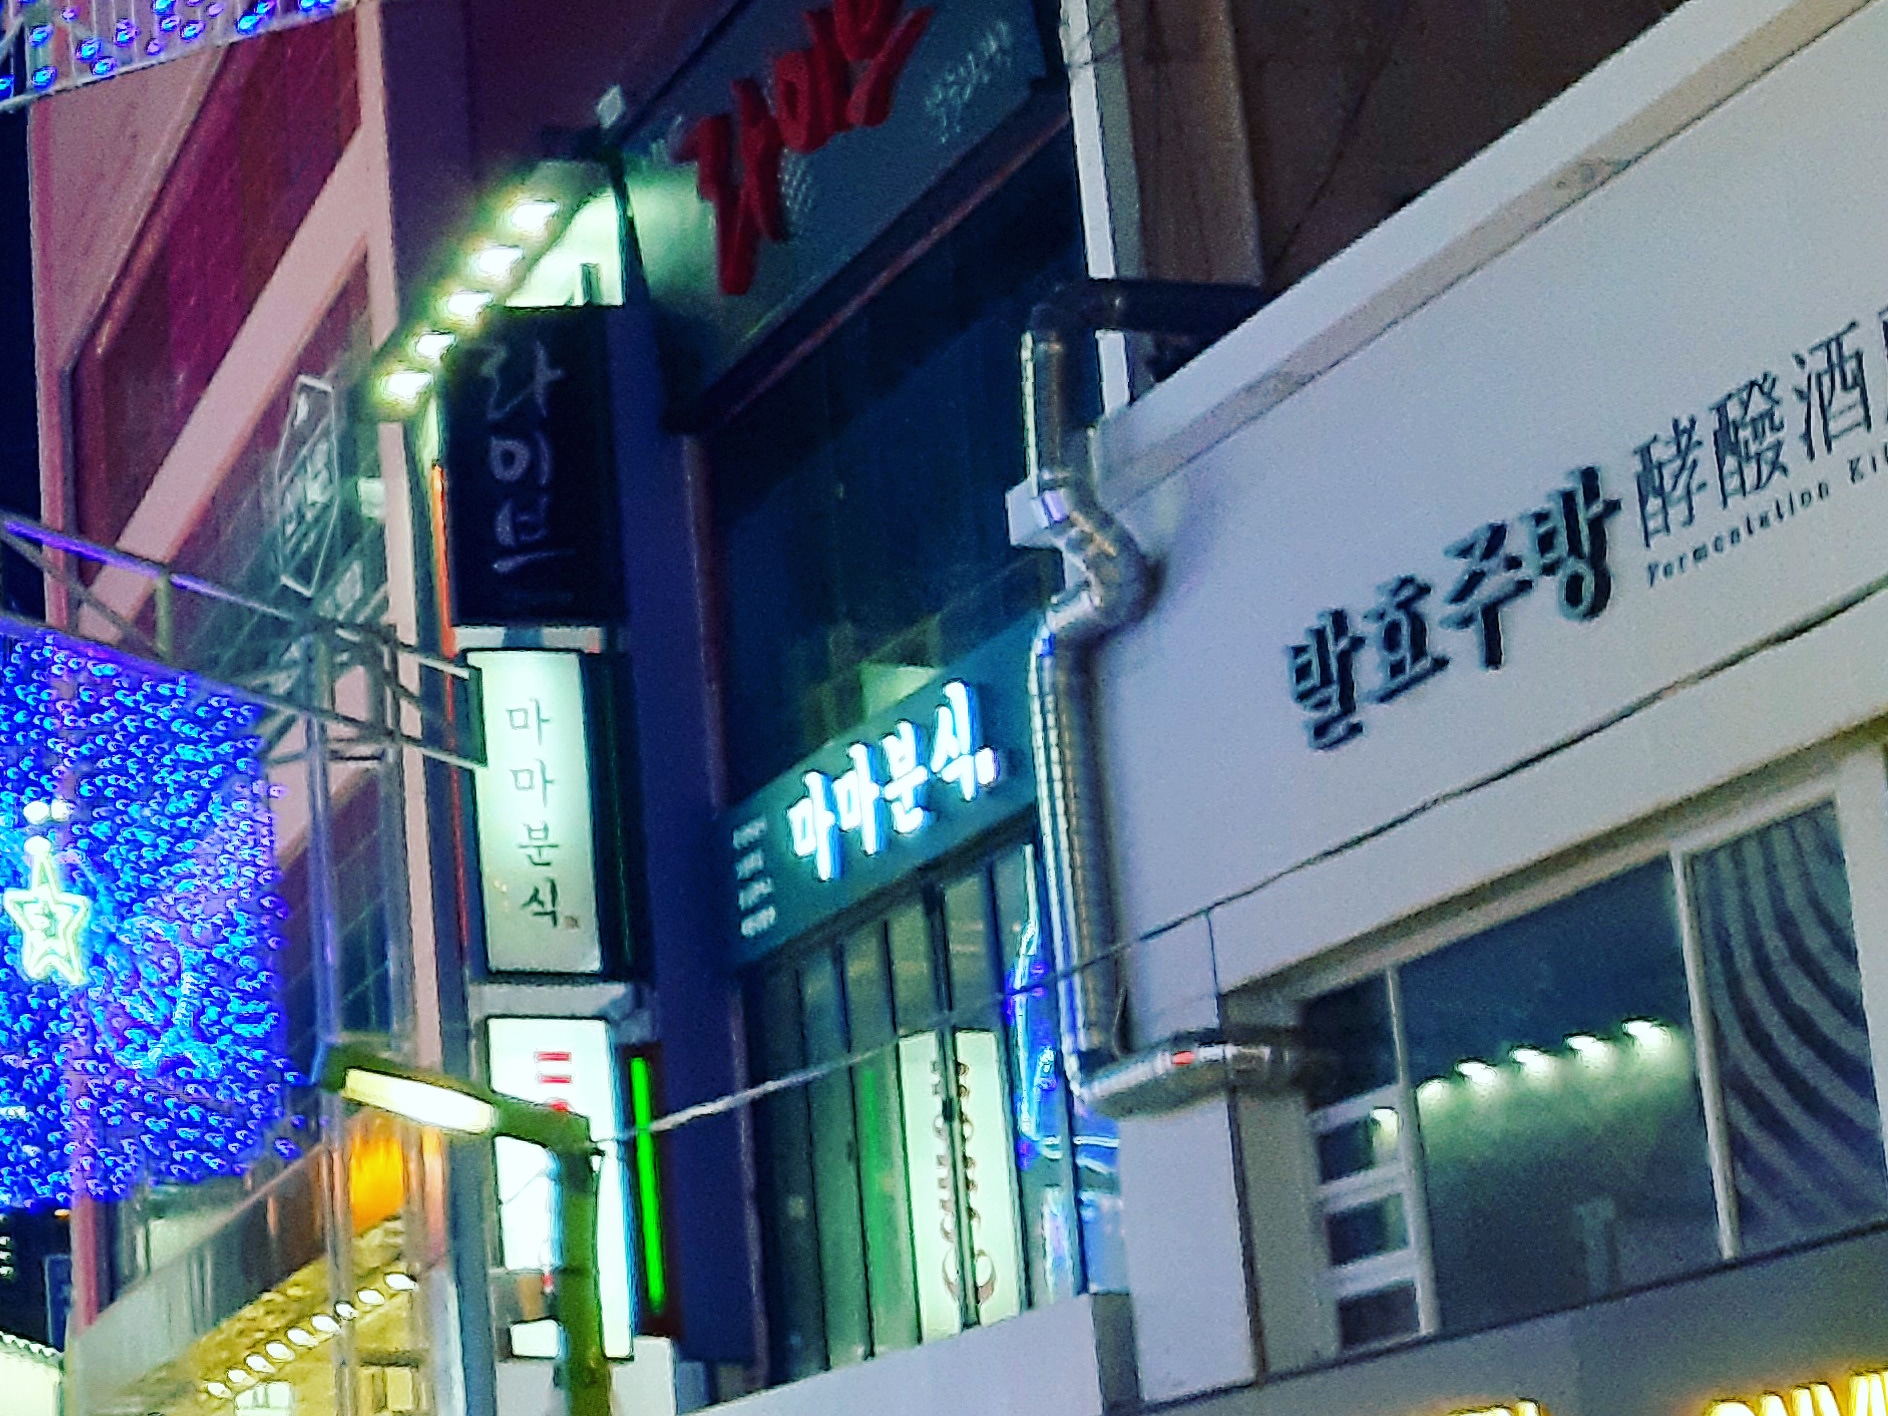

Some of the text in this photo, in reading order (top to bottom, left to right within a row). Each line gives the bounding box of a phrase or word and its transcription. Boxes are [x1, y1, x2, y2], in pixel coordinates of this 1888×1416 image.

[1285, 464, 1625, 751] 발효주방
[505, 698, 561, 930] 마마분식
[785, 677, 998, 883] 마마분식
